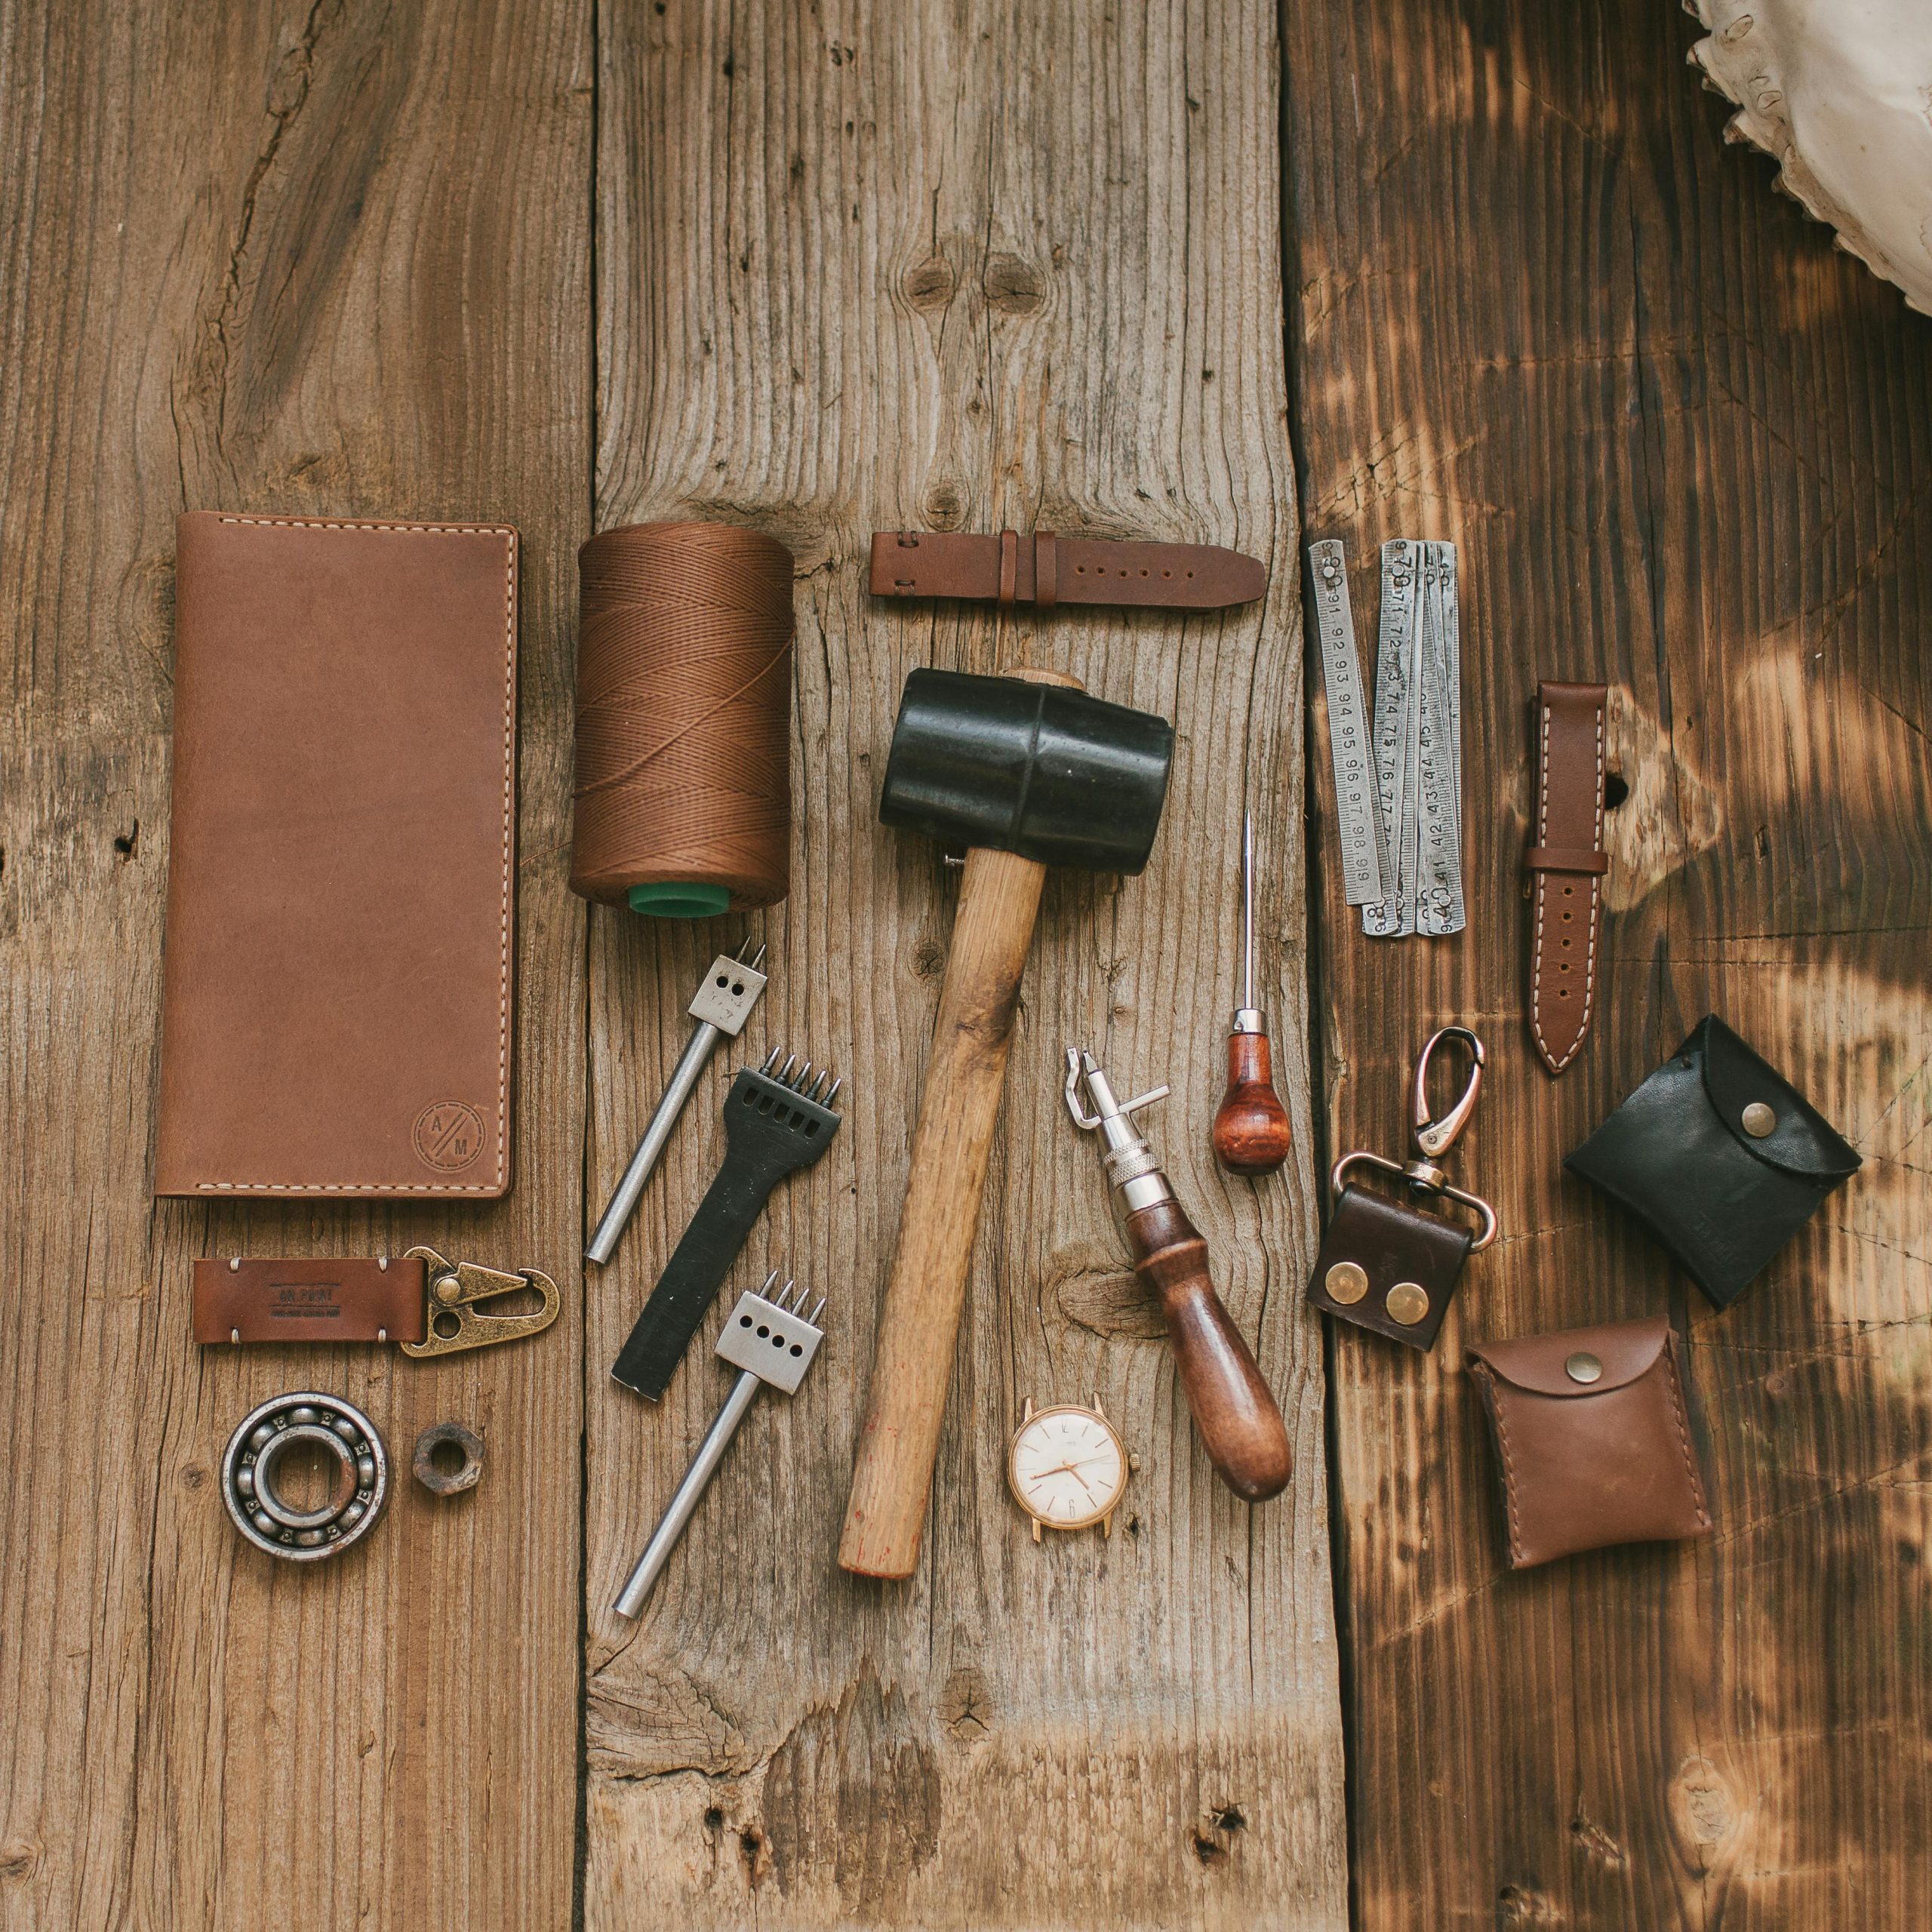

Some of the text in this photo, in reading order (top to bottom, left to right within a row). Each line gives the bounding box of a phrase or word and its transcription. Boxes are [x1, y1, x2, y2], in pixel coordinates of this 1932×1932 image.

[1328, 595, 1341, 614] 91
[1392, 594, 1404, 613] 71
[1331, 628, 1345, 651] 92
[1389, 626, 1403, 648] 72
[1335, 661, 1349, 683] 93
[1339, 694, 1352, 717] 94
[1386, 693, 1399, 714] 74
[1343, 726, 1356, 749] 95
[1383, 725, 1397, 747] 75
[1420, 726, 1432, 748] 45
[1346, 759, 1359, 782] 96
[1382, 758, 1395, 780] 76
[1422, 755, 1436, 780] 44
[1350, 792, 1363, 814] 97
[1380, 792, 1394, 814] 77
[1426, 792, 1439, 814] 43
[1352, 826, 1366, 848] 98
[1430, 826, 1444, 847] 42
[1356, 859, 1370, 881] 99
[1433, 861, 1447, 881] 41
[431, 1115, 442, 1131] A
[454, 1138, 468, 1155] M
[1061, 1418, 1069, 1434] 12
[1069, 1499, 1075, 1518] 6
